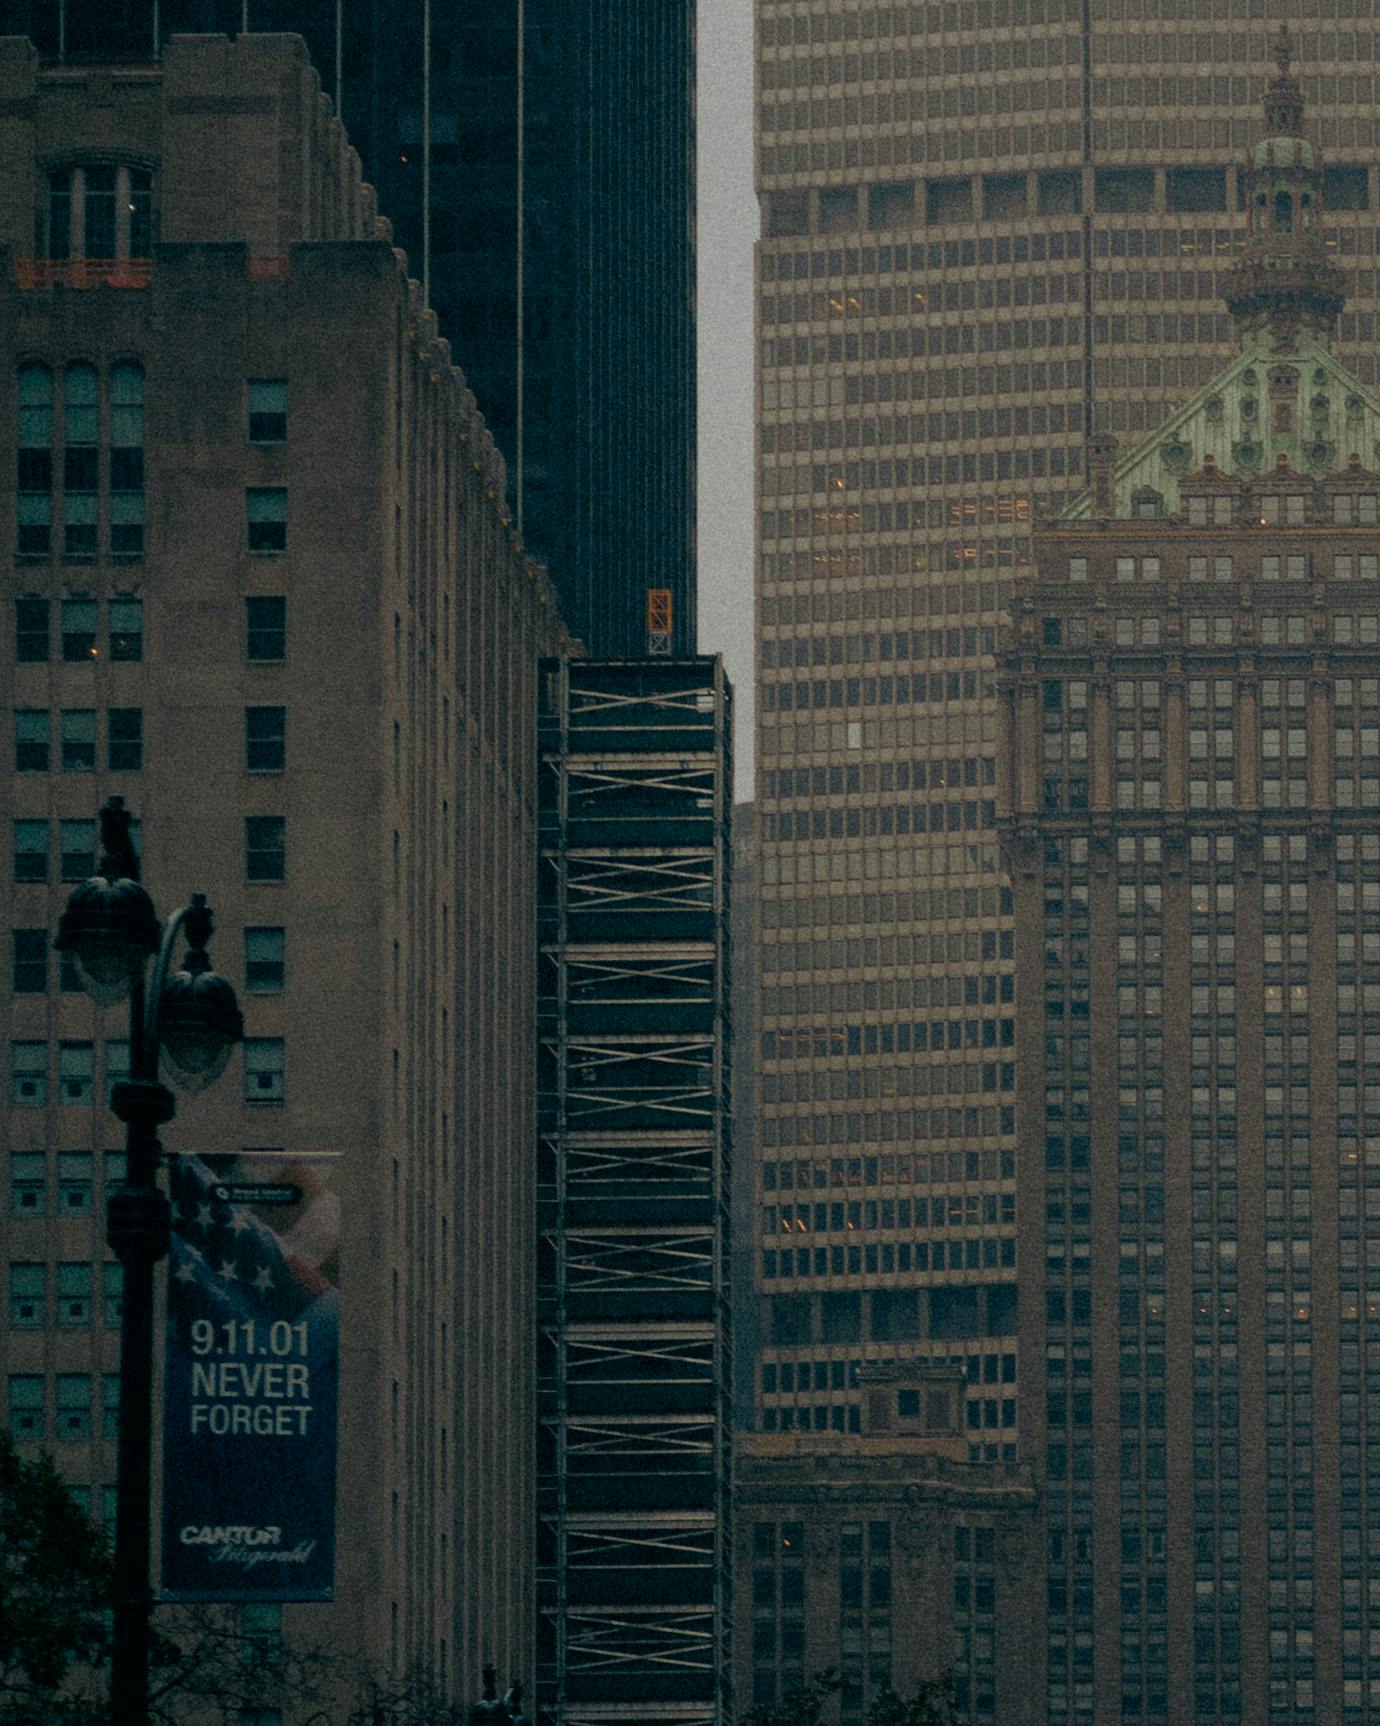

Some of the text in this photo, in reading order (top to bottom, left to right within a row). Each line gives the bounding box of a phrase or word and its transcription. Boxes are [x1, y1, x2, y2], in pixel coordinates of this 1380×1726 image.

[190, 1319, 309, 1356] 9.11.01
[190, 1363, 310, 1399] NEVER
[190, 1405, 313, 1436] FORGET
[179, 1525, 282, 1545] CANTOR
